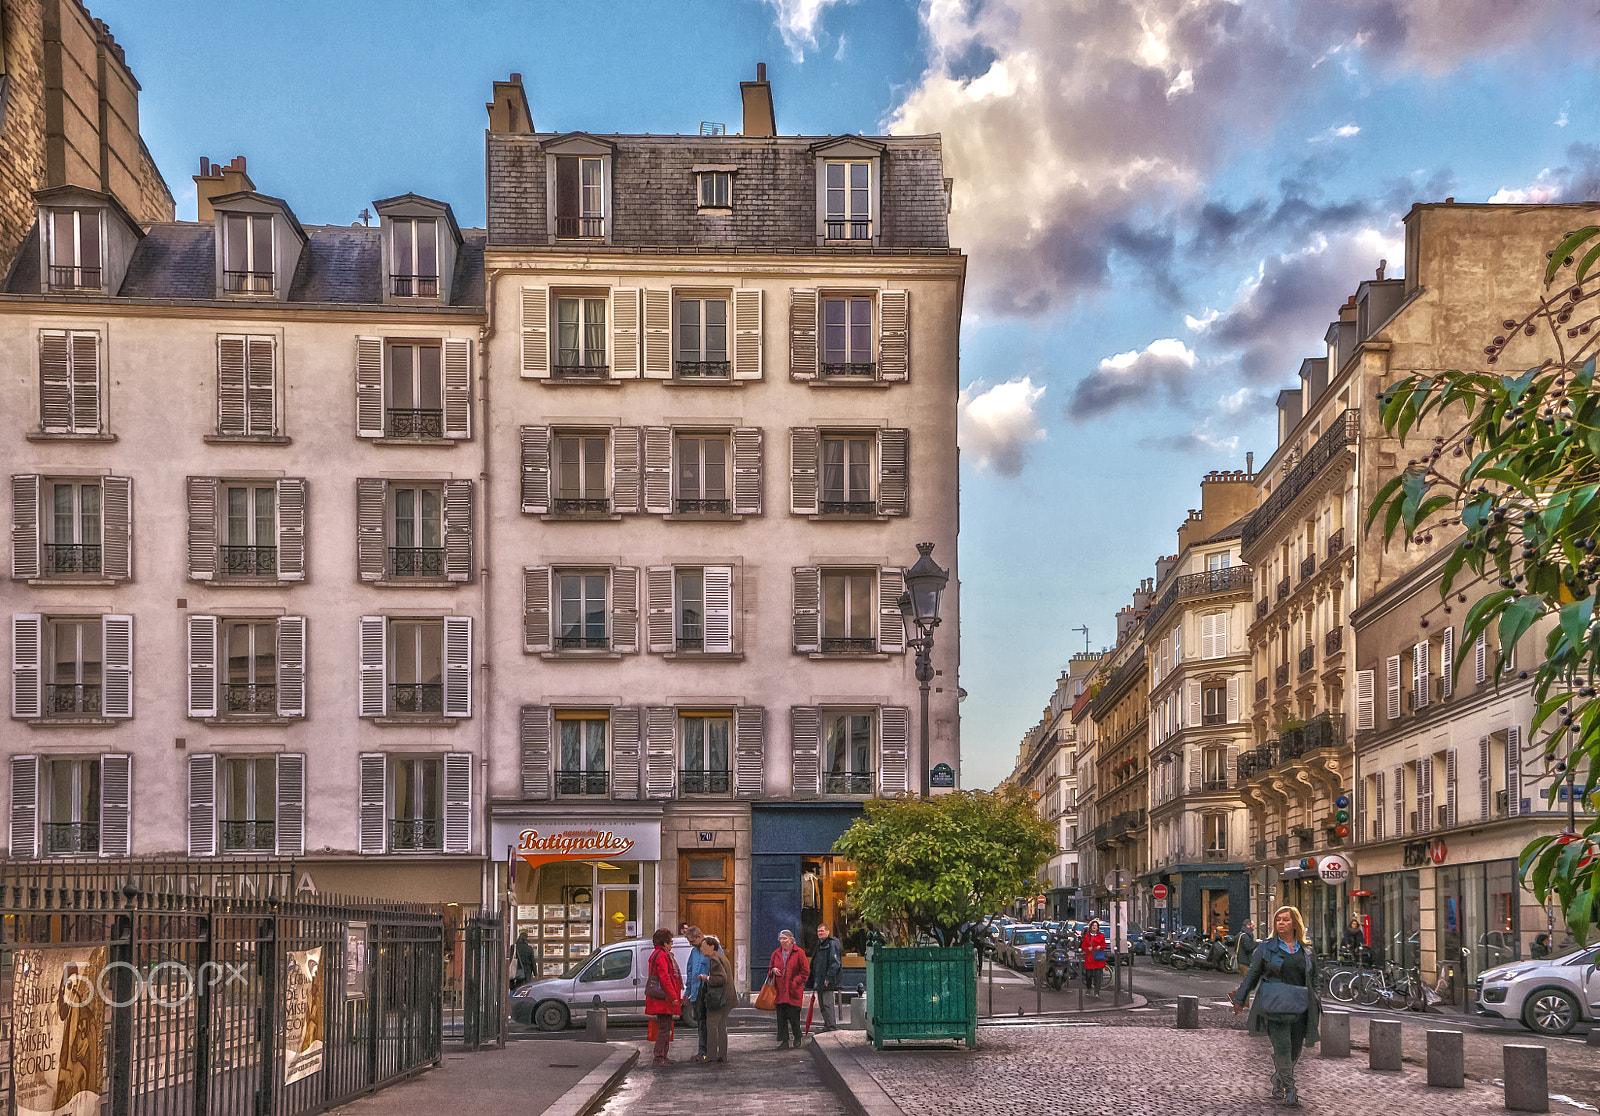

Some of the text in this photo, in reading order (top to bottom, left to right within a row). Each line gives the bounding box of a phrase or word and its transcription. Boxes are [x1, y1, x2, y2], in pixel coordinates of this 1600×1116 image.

[517, 828, 635, 855] Batignolles
[701, 832, 711, 841] 70
[1321, 870, 1348, 879] HSBC
[20, 1010, 50, 1029] DE LA
[20, 1053, 56, 1077] CORDE
